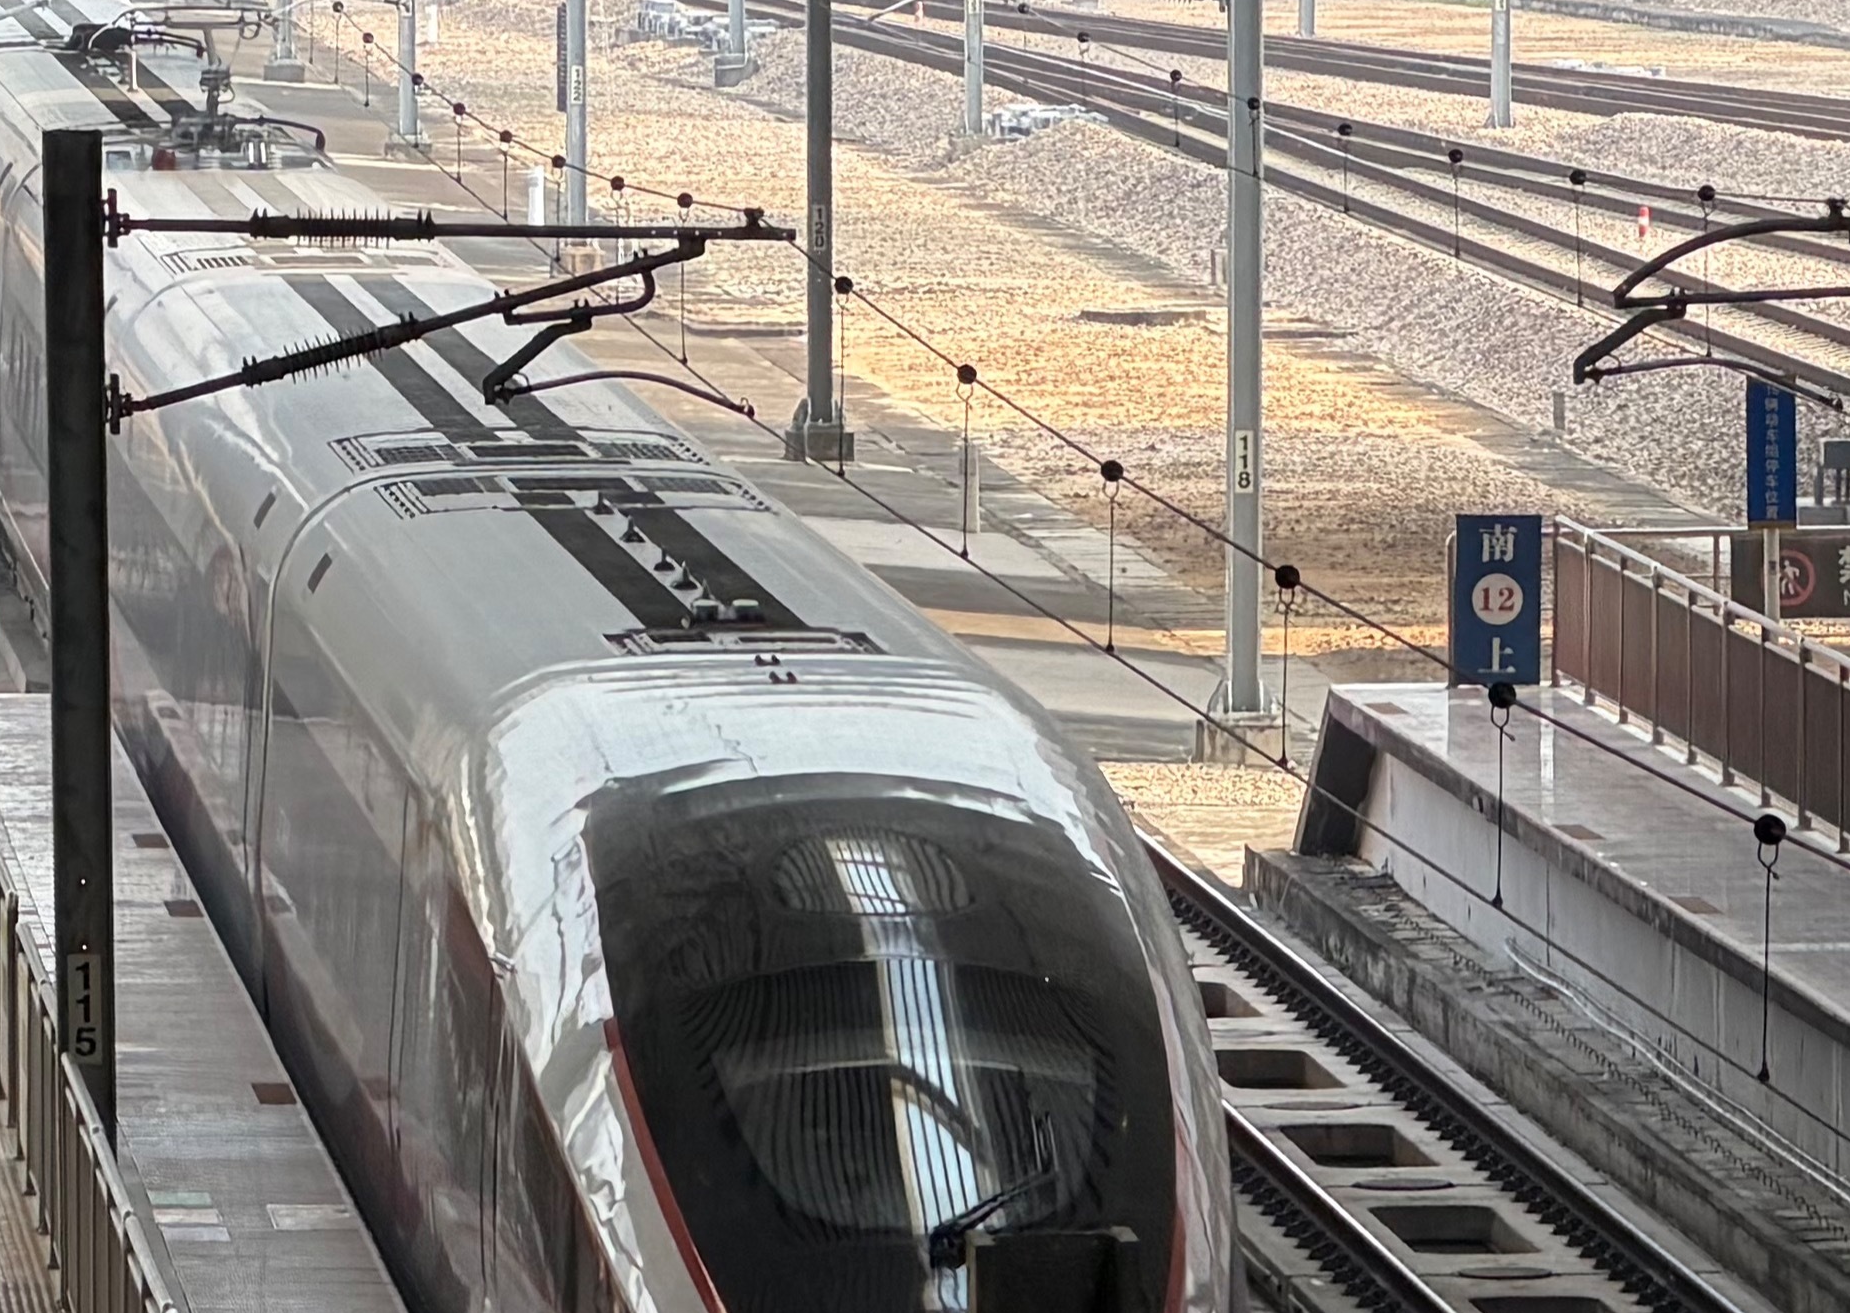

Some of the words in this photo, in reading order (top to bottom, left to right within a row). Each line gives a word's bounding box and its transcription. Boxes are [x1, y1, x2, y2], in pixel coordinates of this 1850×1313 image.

[815, 207, 825, 248] 120
[1238, 434, 1251, 489] 118
[1479, 523, 1517, 563] 南
[1479, 587, 1516, 612] 12
[1477, 637, 1516, 674] 上
[75, 961, 97, 1057] 115
